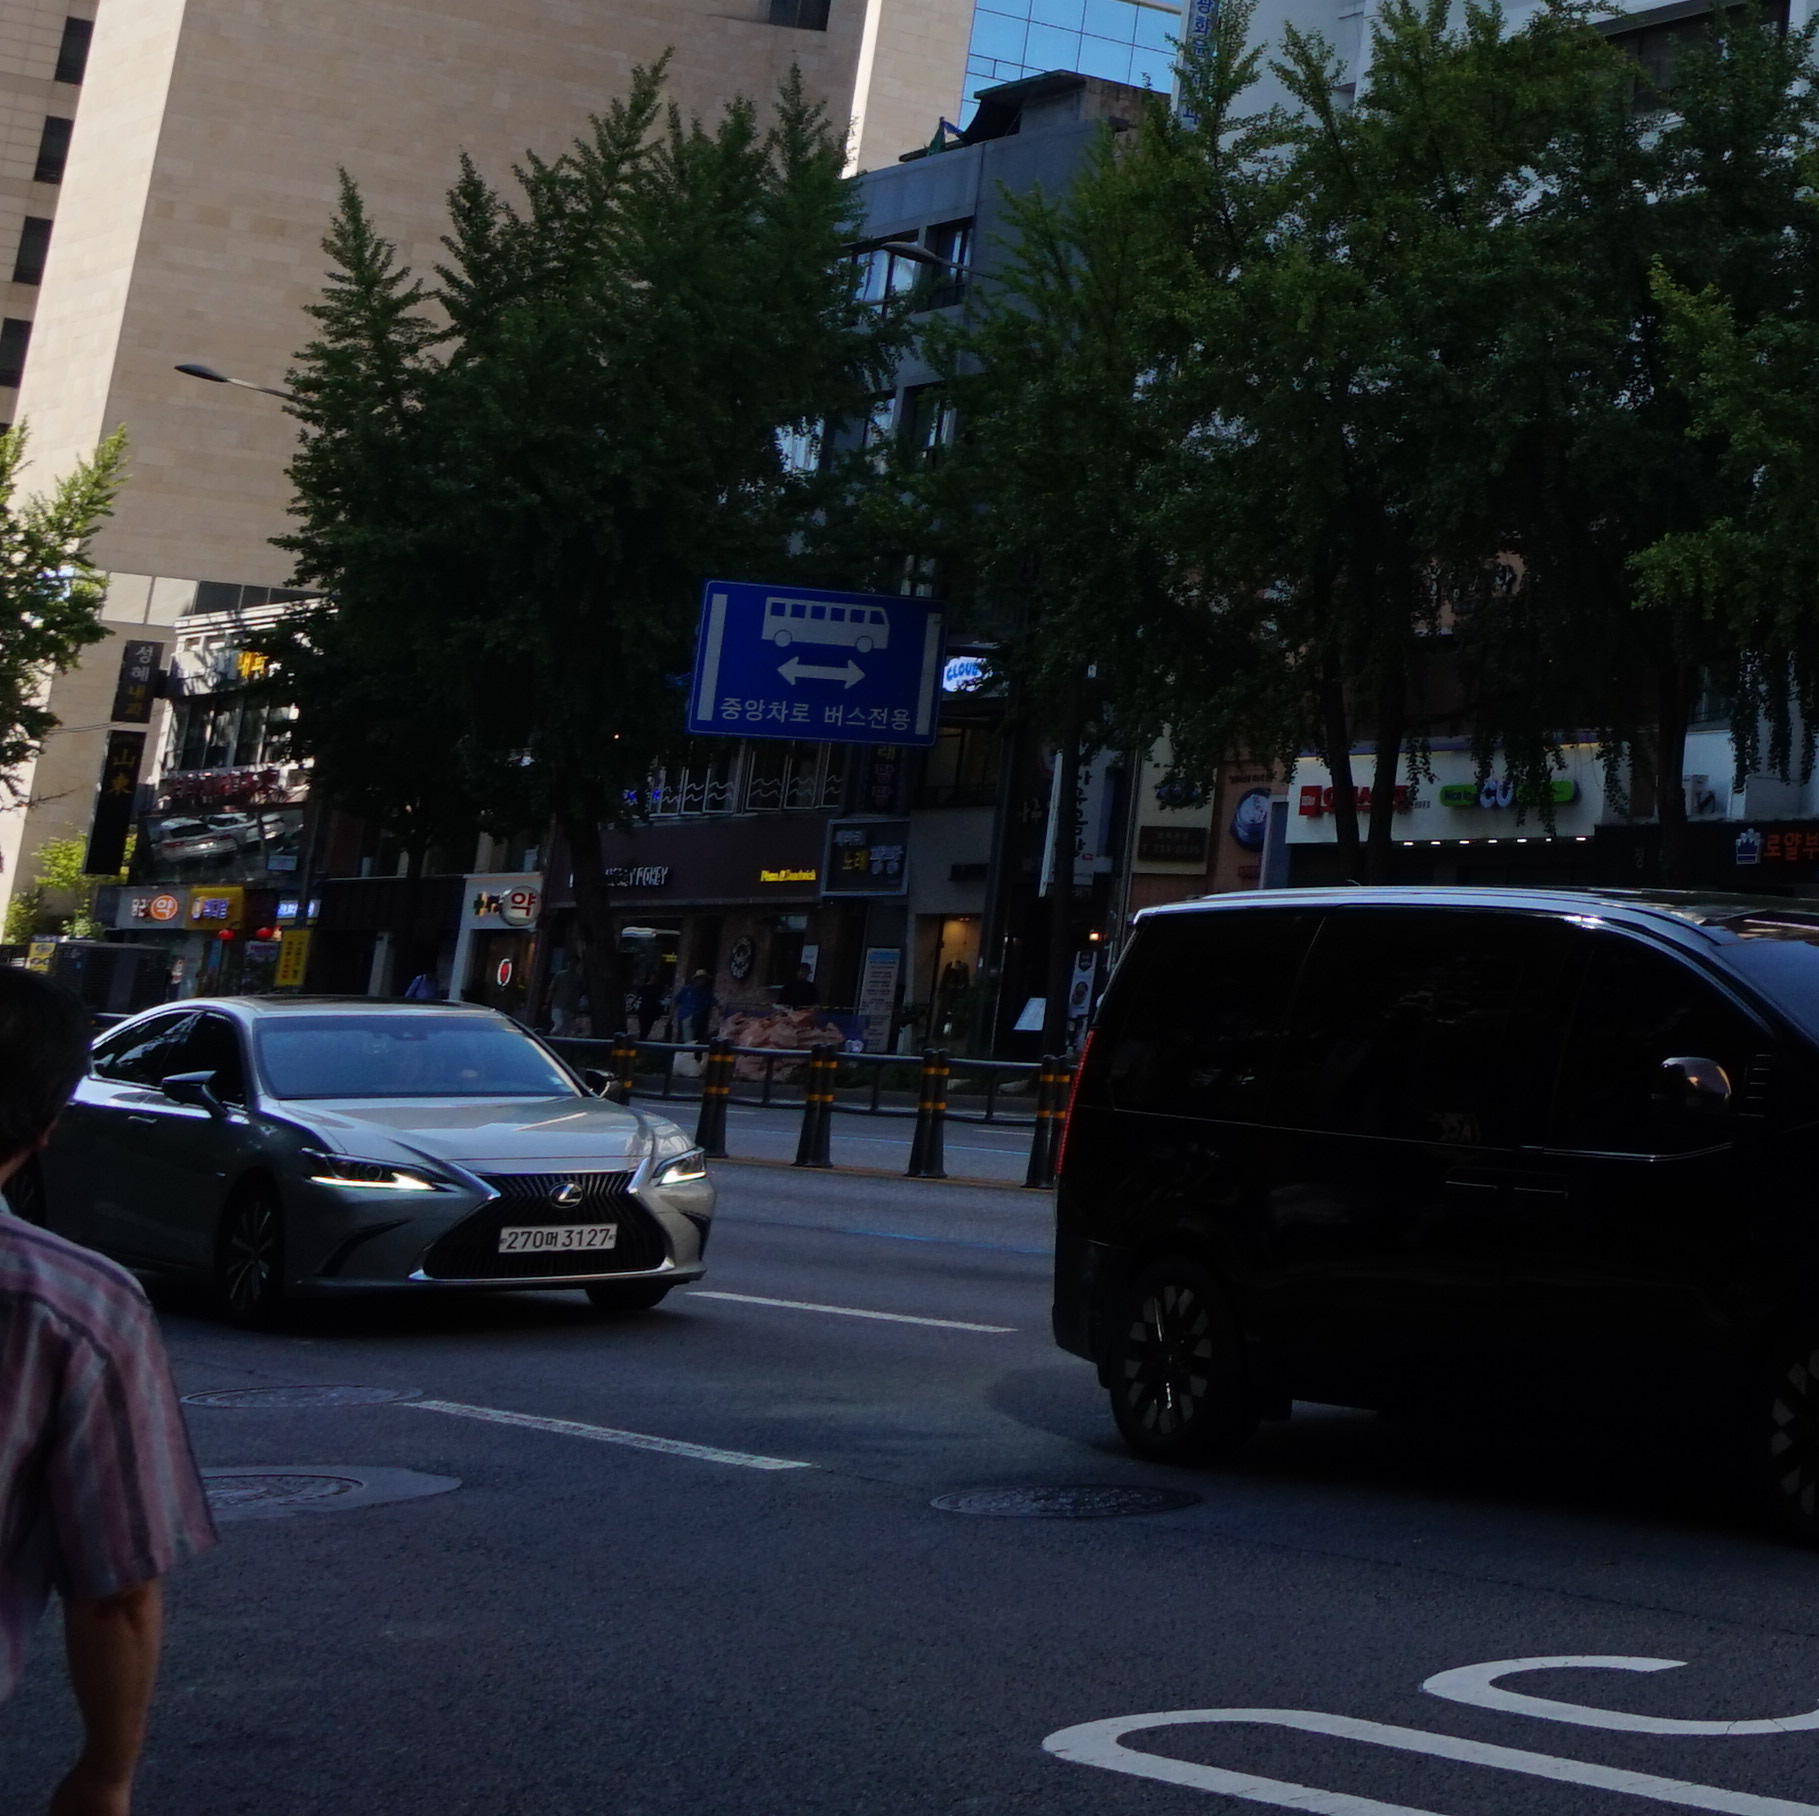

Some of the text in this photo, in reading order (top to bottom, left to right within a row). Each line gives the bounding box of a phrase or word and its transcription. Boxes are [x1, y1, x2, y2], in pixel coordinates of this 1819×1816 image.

[720, 697, 912, 730] 중앙차로 버스전용
[511, 892, 537, 917] 약
[561, 1228, 611, 1248] 3127
